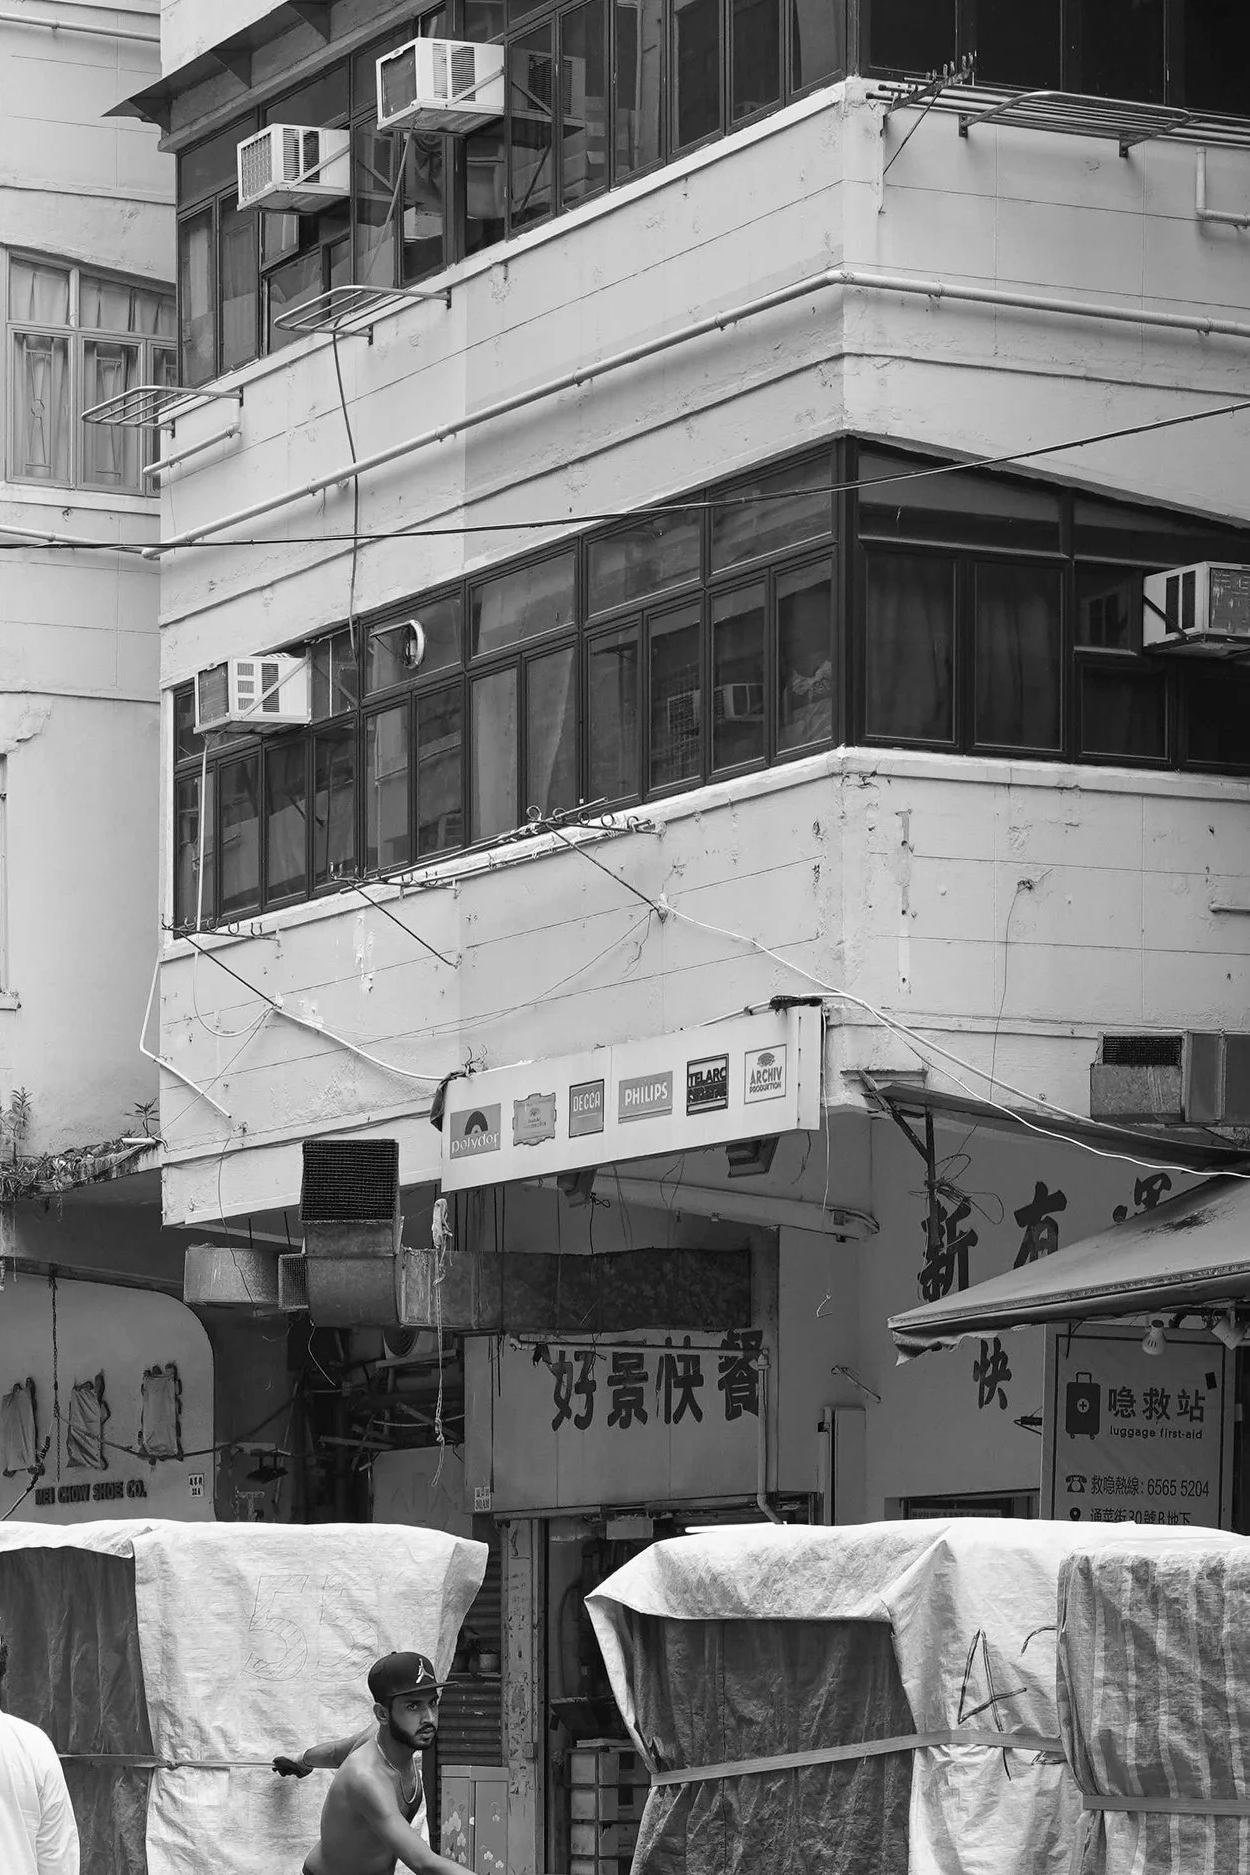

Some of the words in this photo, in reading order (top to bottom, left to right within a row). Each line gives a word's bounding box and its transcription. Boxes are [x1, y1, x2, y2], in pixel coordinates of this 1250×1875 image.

[749, 1066, 783, 1085] ARCHIV
[572, 1088, 601, 1111] DECCA
[624, 1081, 669, 1107] PHILIPS
[451, 1130, 500, 1155] polydor
[1107, 1385, 1206, 1423] 喼救站
[1109, 1425, 1157, 1440] luggage
[1159, 1429, 1204, 1441] first-aid
[57, 1483, 92, 1504] CHOW
[93, 1481, 125, 1501] SHOE
[126, 1478, 147, 1499] CO.
[1147, 1478, 1177, 1497] 6565
[1180, 1479, 1210, 1498] 5204
